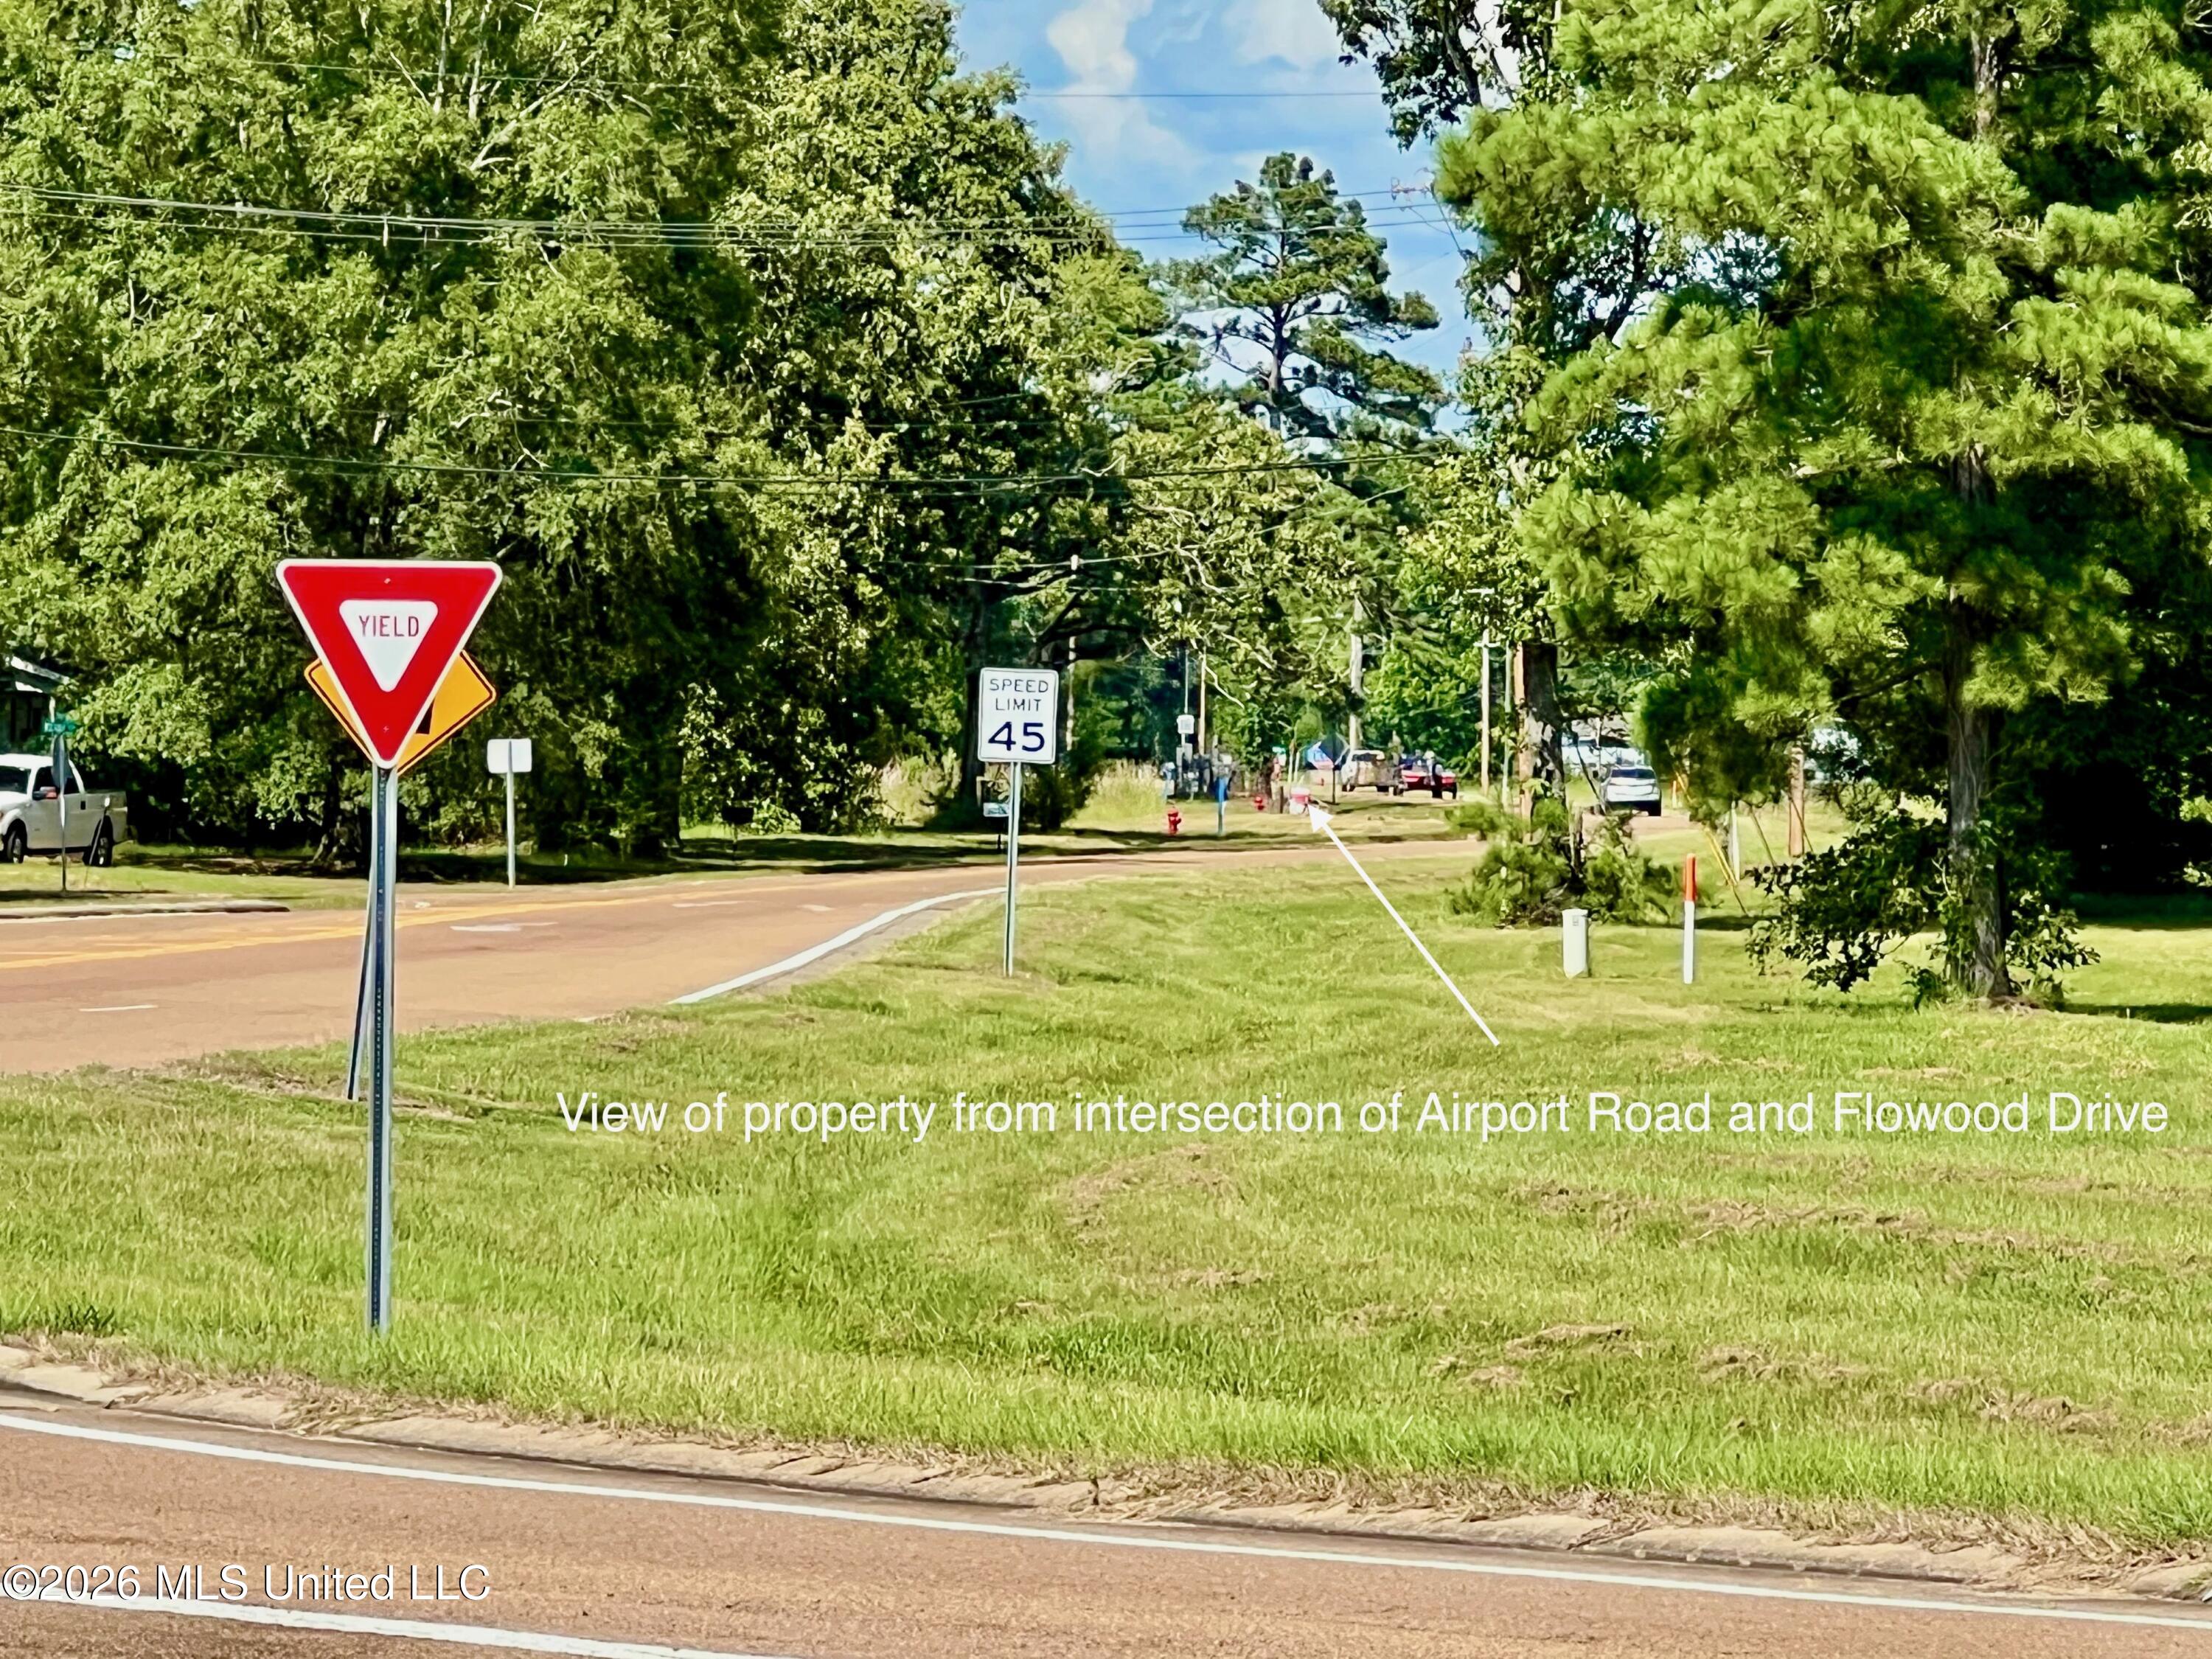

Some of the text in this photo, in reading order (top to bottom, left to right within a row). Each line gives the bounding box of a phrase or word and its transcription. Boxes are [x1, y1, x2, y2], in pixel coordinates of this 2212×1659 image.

[358, 614, 420, 638] YIELD
[989, 678, 1048, 693] SPEED
[995, 698, 1042, 712] LIMIT
[987, 721, 1046, 752] 45
